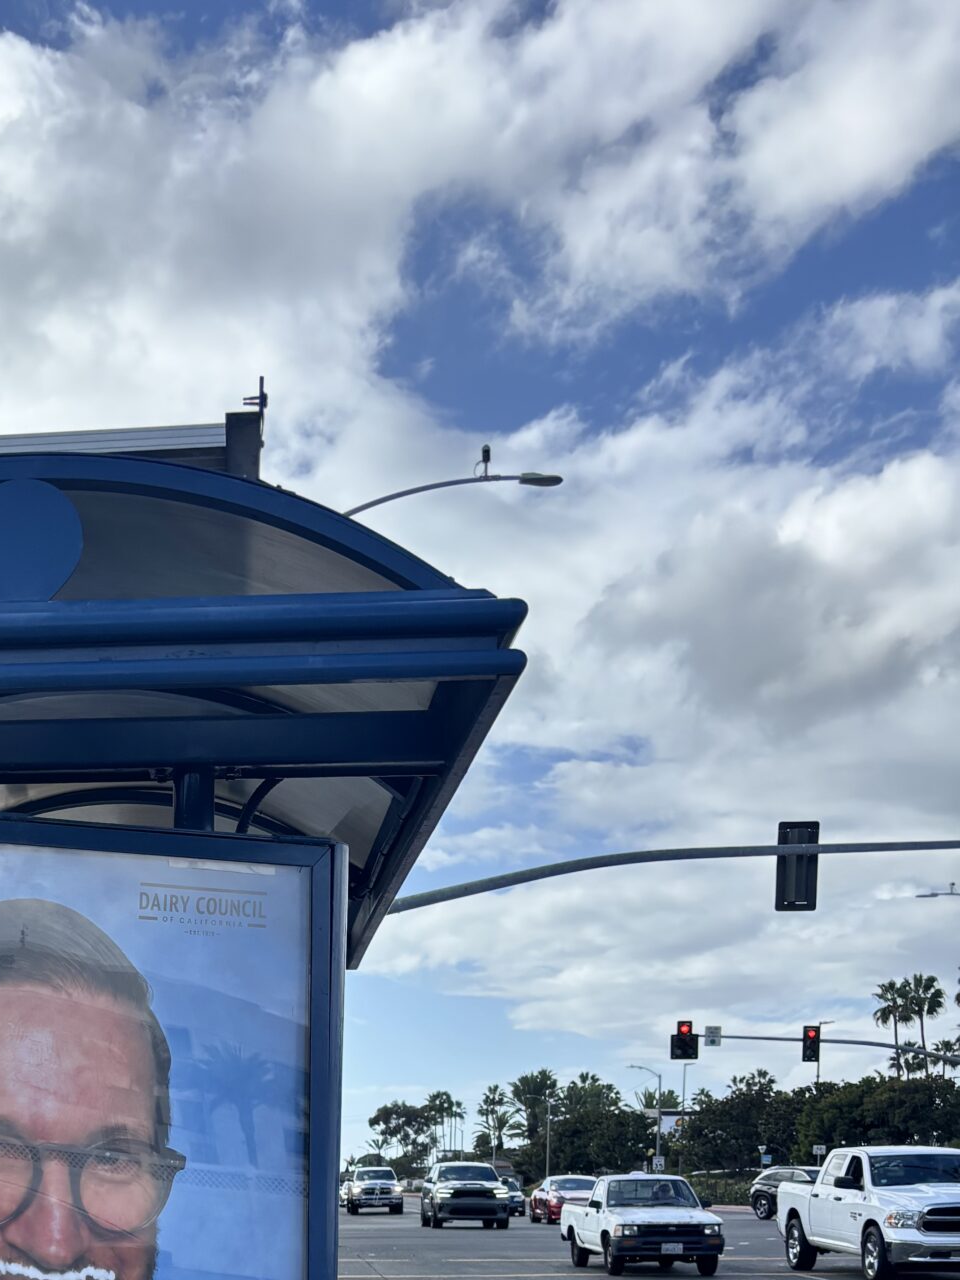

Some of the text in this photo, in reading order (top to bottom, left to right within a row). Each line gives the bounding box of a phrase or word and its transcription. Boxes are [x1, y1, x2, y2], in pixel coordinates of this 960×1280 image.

[139, 891, 267, 919] DAIRY COUNCIL
[179, 917, 243, 928] CALIFORNIA
